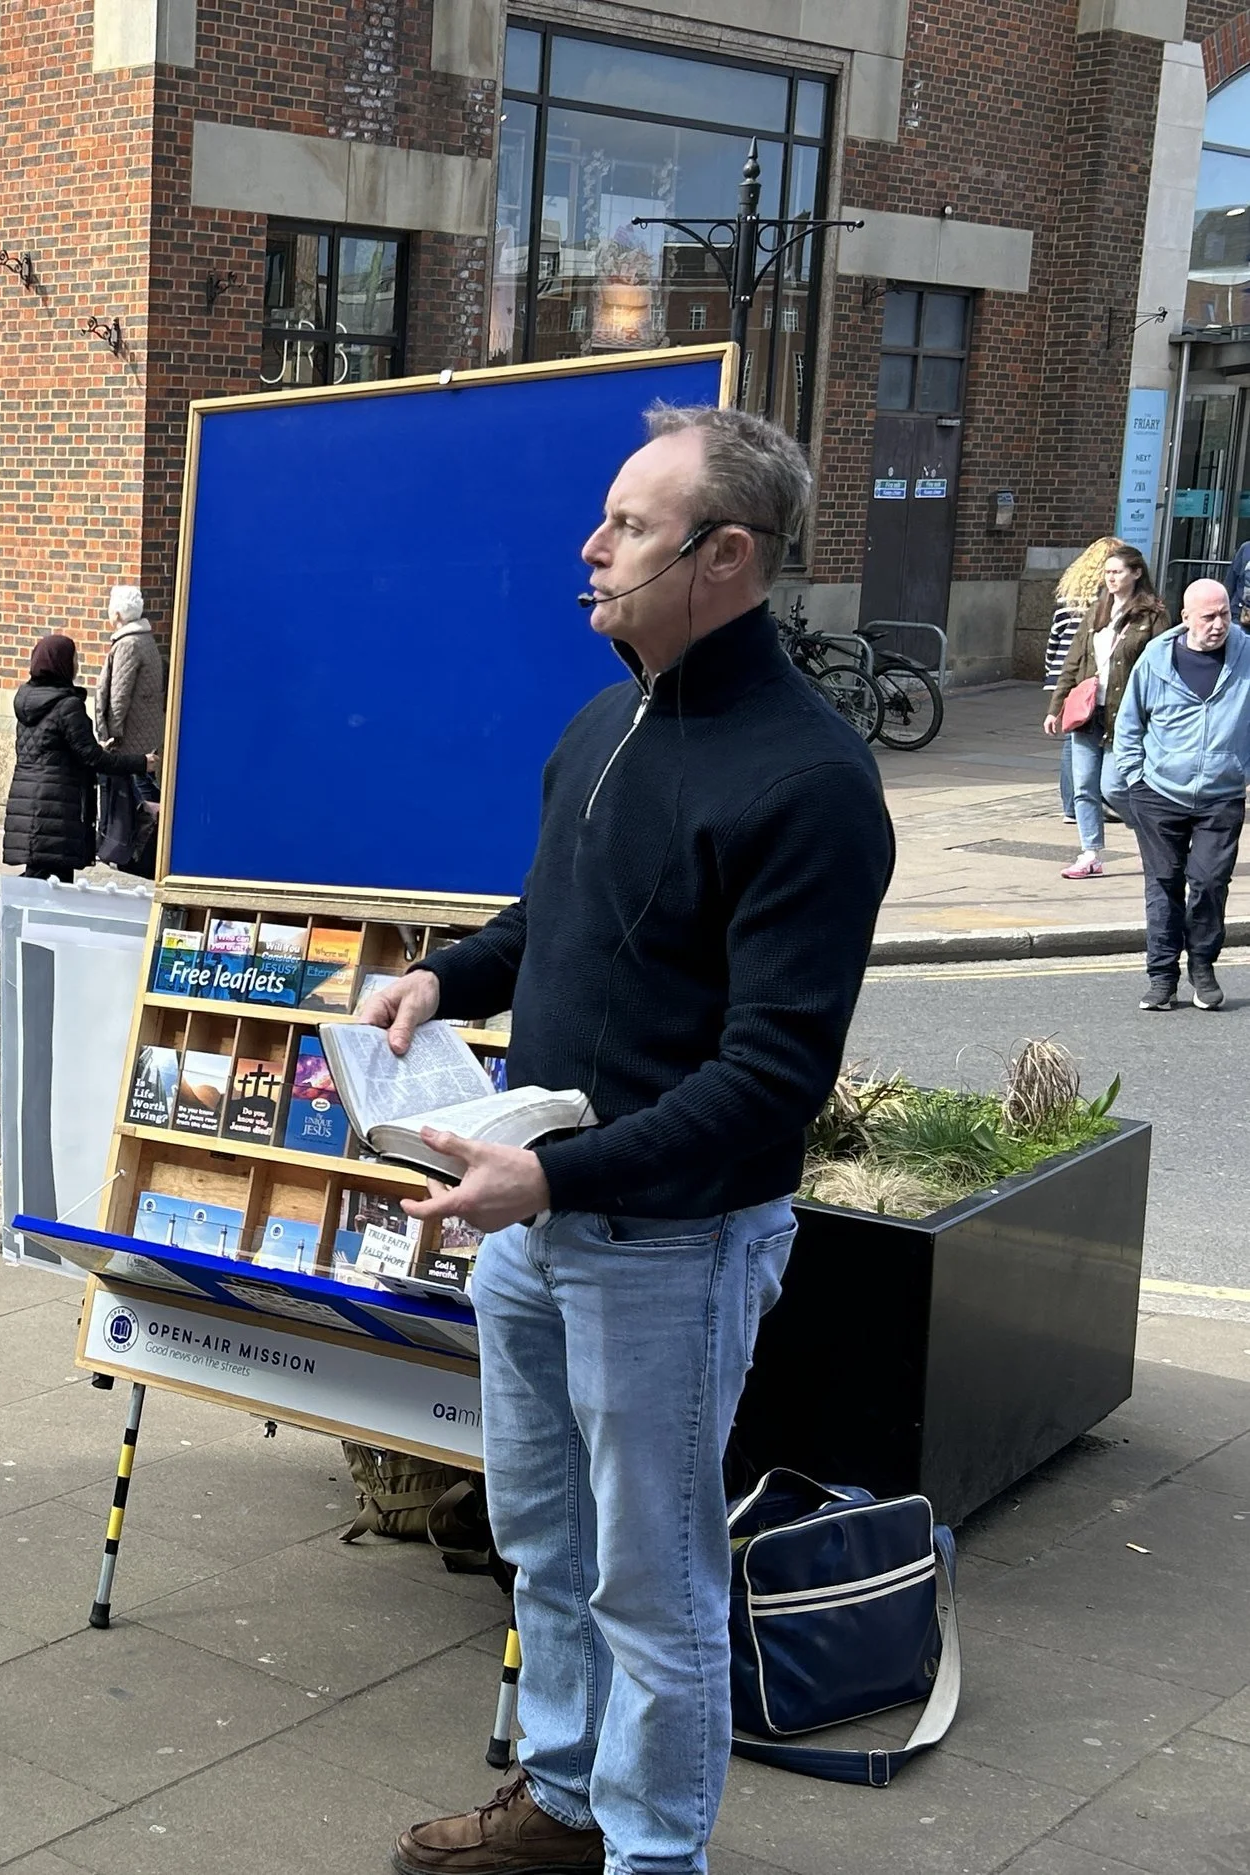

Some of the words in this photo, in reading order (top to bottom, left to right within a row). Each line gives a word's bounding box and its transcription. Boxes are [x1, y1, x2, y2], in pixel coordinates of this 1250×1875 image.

[1133, 418, 1161, 430] FRIARY
[265, 942, 283, 951] Will
[285, 943, 301, 953] You
[261, 951, 302, 963] Consider
[260, 962, 297, 975] JESUS?
[170, 960, 211, 987] Free
[213, 964, 286, 994] leaflets
[136, 1078, 146, 1087] Is
[134, 1088, 155, 1100] Life
[132, 1098, 166, 1112] Worth
[130, 1109, 169, 1124] Living?
[177, 1112, 189, 1120] why
[243, 1107, 252, 1115] Do
[253, 1109, 266, 1118] you
[176, 1118, 190, 1126] from
[237, 1115, 255, 1124] know
[255, 1118, 269, 1127] why
[304, 1116, 333, 1127] UNIQUE
[230, 1122, 251, 1133] Jesus
[252, 1125, 273, 1136] died?
[301, 1124, 332, 1138] JESUS
[368, 1228, 387, 1243] TRUE
[388, 1234, 411, 1251] FAITH
[363, 1246, 383, 1260] FALSE
[384, 1254, 406, 1268] HOPE
[434, 1260, 449, 1270] God
[449, 1261, 456, 1271] is
[428, 1269, 459, 1281] merciful.
[148, 1321, 231, 1354] OPEN-AIR
[239, 1343, 316, 1374] MISSION
[145, 1340, 169, 1357] Good
[168, 1348, 191, 1363] news
[192, 1354, 203, 1364] on
[205, 1356, 220, 1370] the
[221, 1361, 251, 1377] streets
